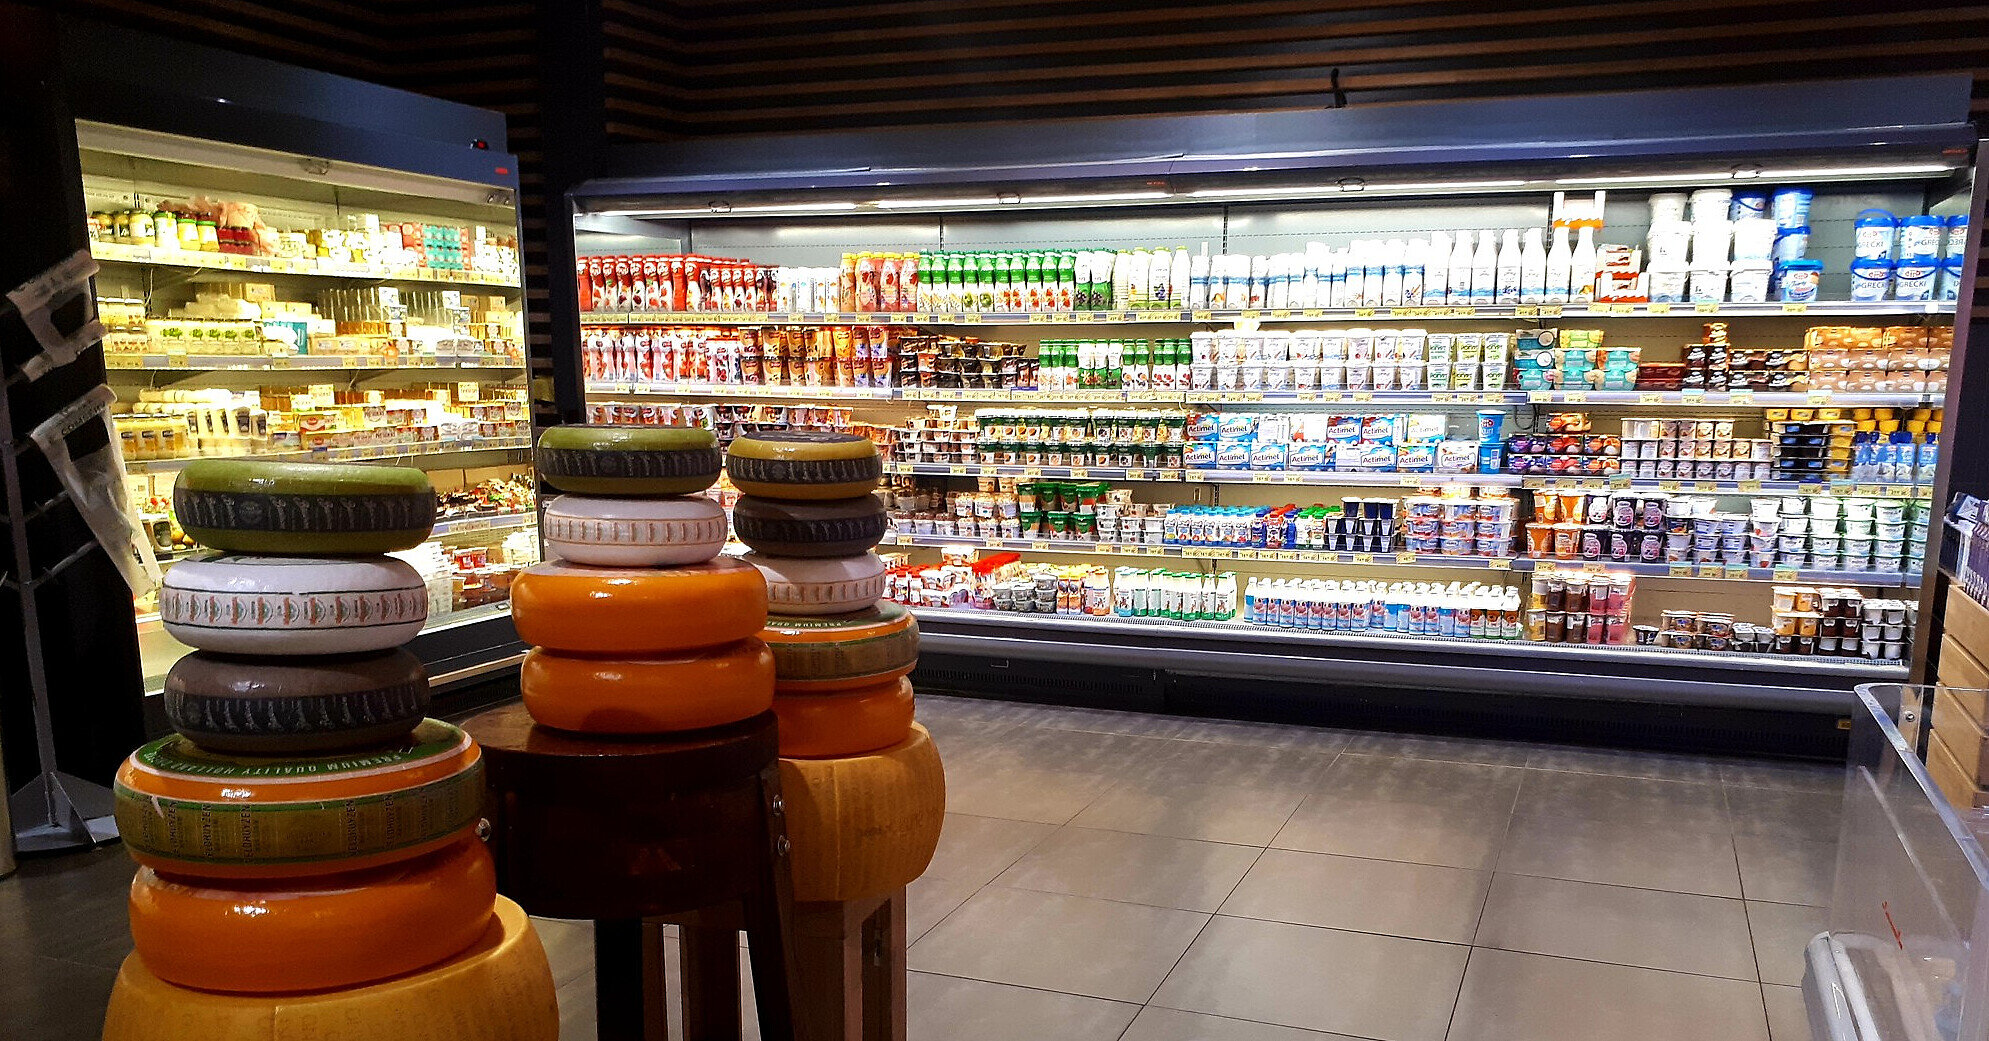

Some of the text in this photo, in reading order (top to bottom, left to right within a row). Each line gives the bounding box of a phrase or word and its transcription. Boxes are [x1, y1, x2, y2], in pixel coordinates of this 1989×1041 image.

[1188, 425, 1215, 433] Actimel
[1221, 425, 1248, 434] Actimel
[1328, 426, 1356, 434] Actimel
[1362, 427, 1388, 435] Actimel
[1185, 453, 1212, 462] Actimel
[1219, 453, 1246, 462] Actimel
[1252, 453, 1279, 462] Actimel
[1291, 454, 1319, 462] Actimel
[1362, 455, 1391, 463] Actimel
[1399, 456, 1429, 464] Actimel
[327, 754, 402, 771] PREMIUM
[241, 765, 317, 775] QUALITY
